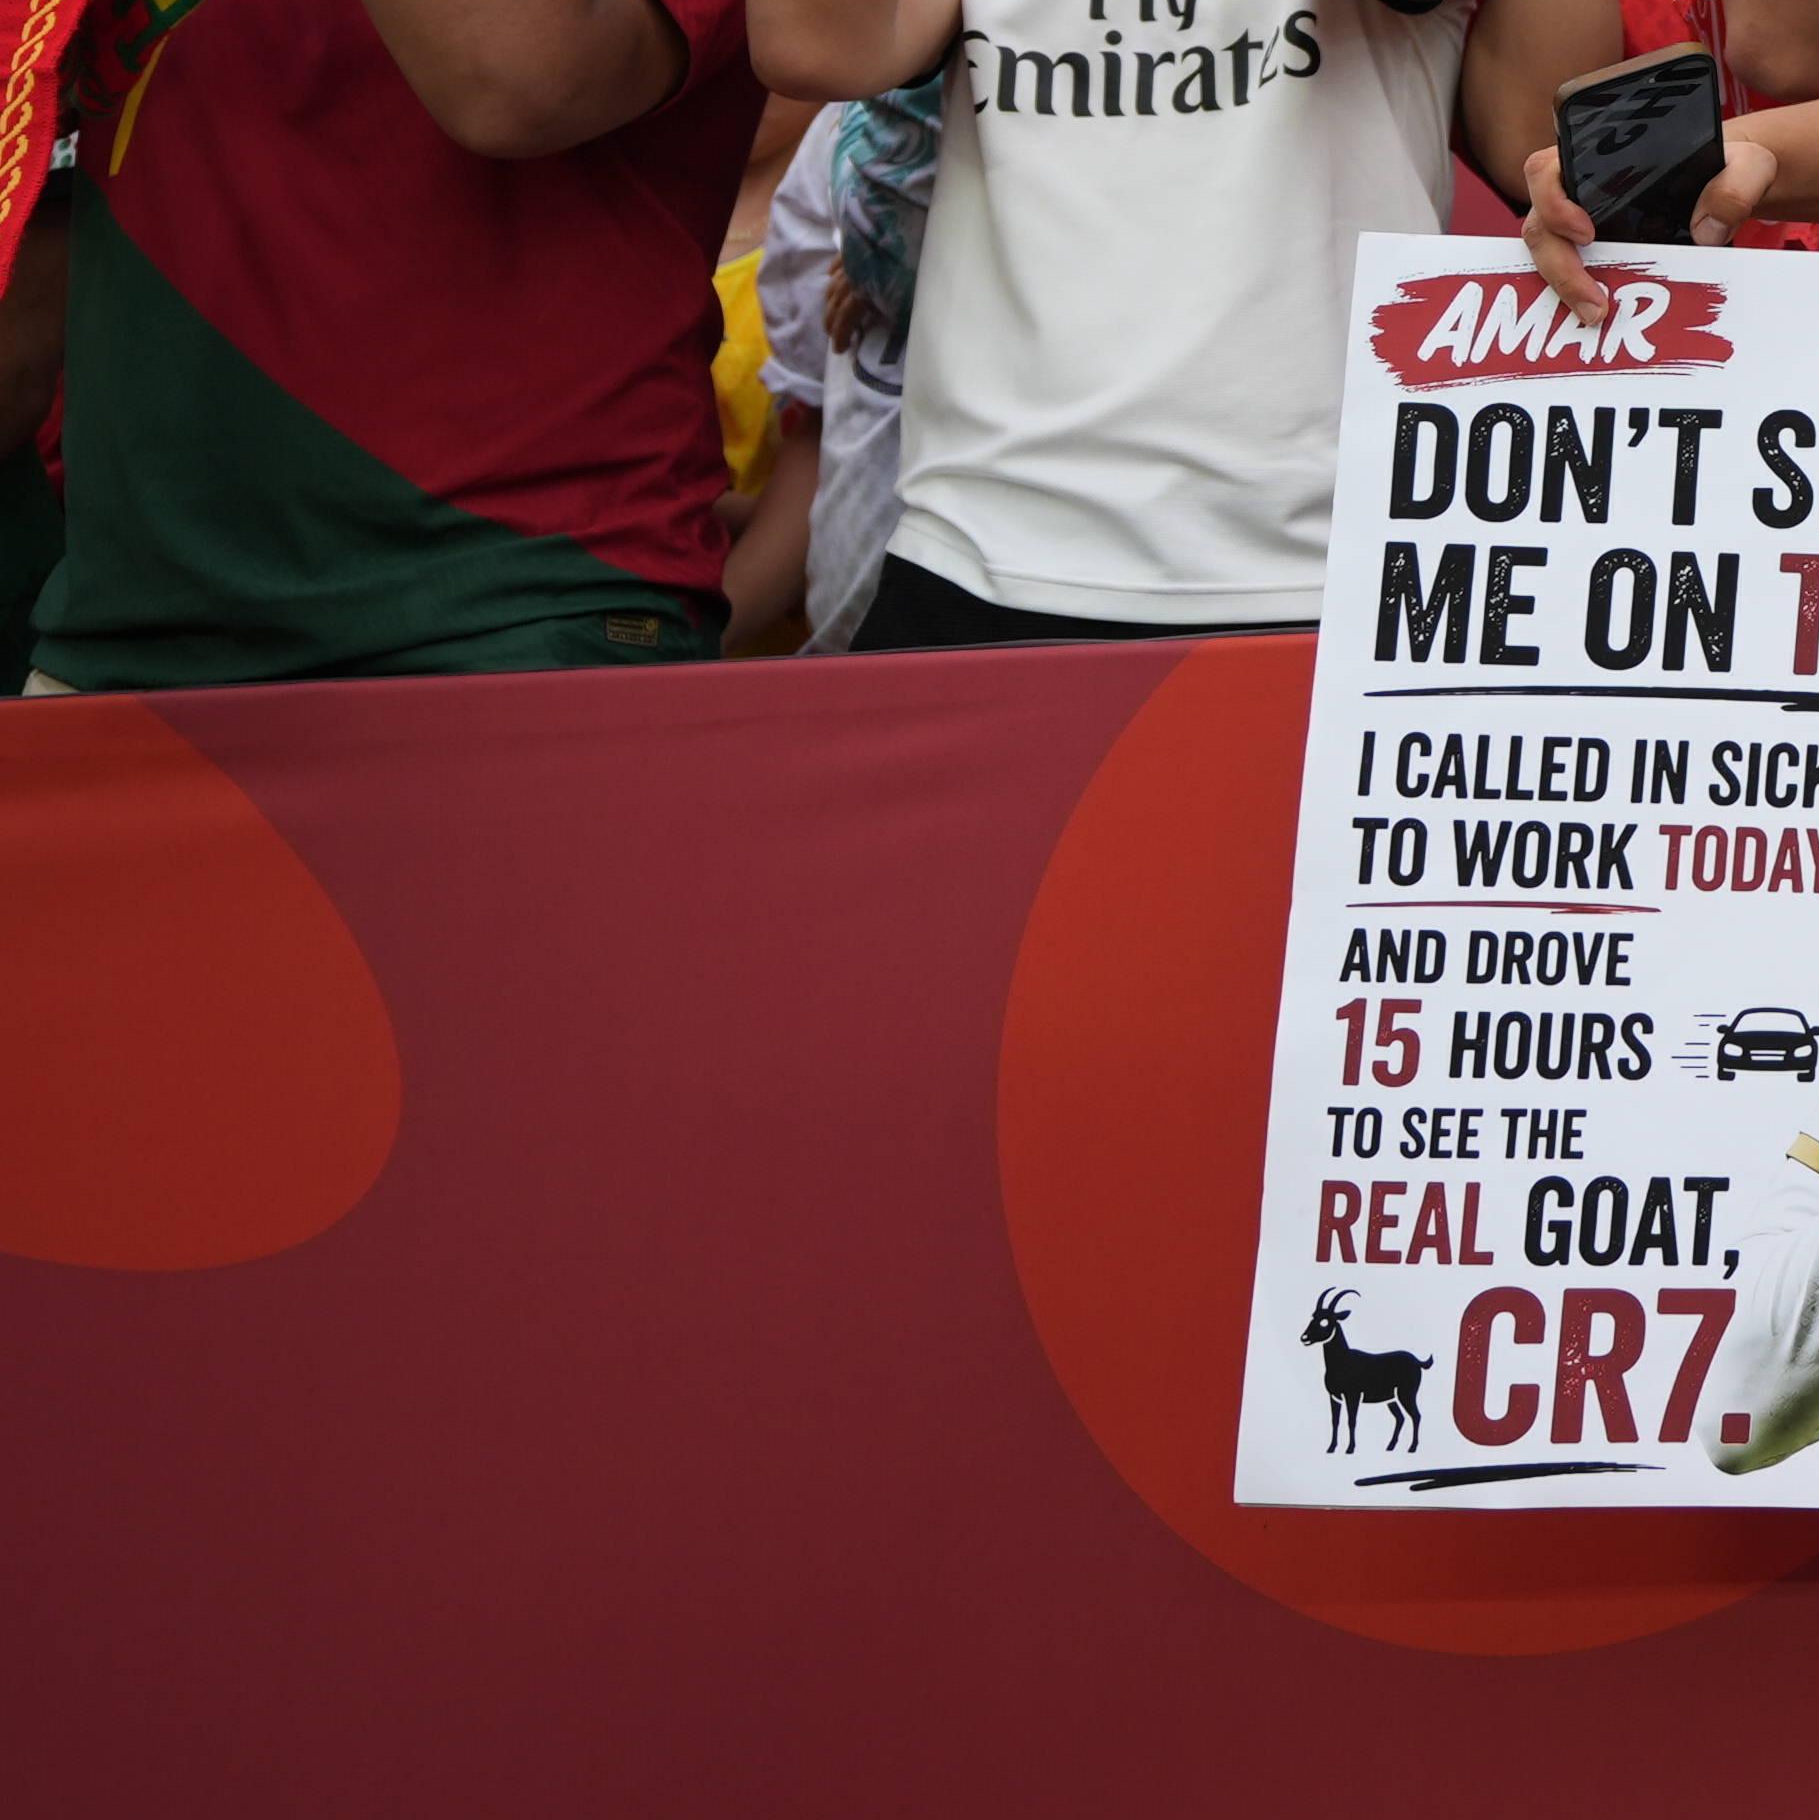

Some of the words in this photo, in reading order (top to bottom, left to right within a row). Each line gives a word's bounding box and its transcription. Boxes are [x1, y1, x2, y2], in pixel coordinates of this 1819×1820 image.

[1417, 281, 1670, 367] AMAR
[1389, 403, 1722, 525] DON'T
[1375, 542, 1548, 666] ME
[1585, 548, 1738, 672] ON
[1358, 731, 1375, 796] I
[1396, 732, 1610, 802] CALLED
[1631, 740, 1683, 804] IN
[1353, 818, 1427, 886] TO
[1454, 820, 1637, 889] WORK
[1340, 929, 1446, 983] AND
[1467, 931, 1633, 986] DROVE
[1336, 999, 1421, 1087] 15
[1449, 1012, 1653, 1080] HOURS
[1328, 1107, 1382, 1158] TO
[1400, 1107, 1483, 1159] SEE
[1501, 1109, 1586, 1159] THE
[1316, 1180, 1493, 1265] REAL
[1524, 1176, 1739, 1279] GOAT,
[1453, 1287, 1751, 1445] CR7.
